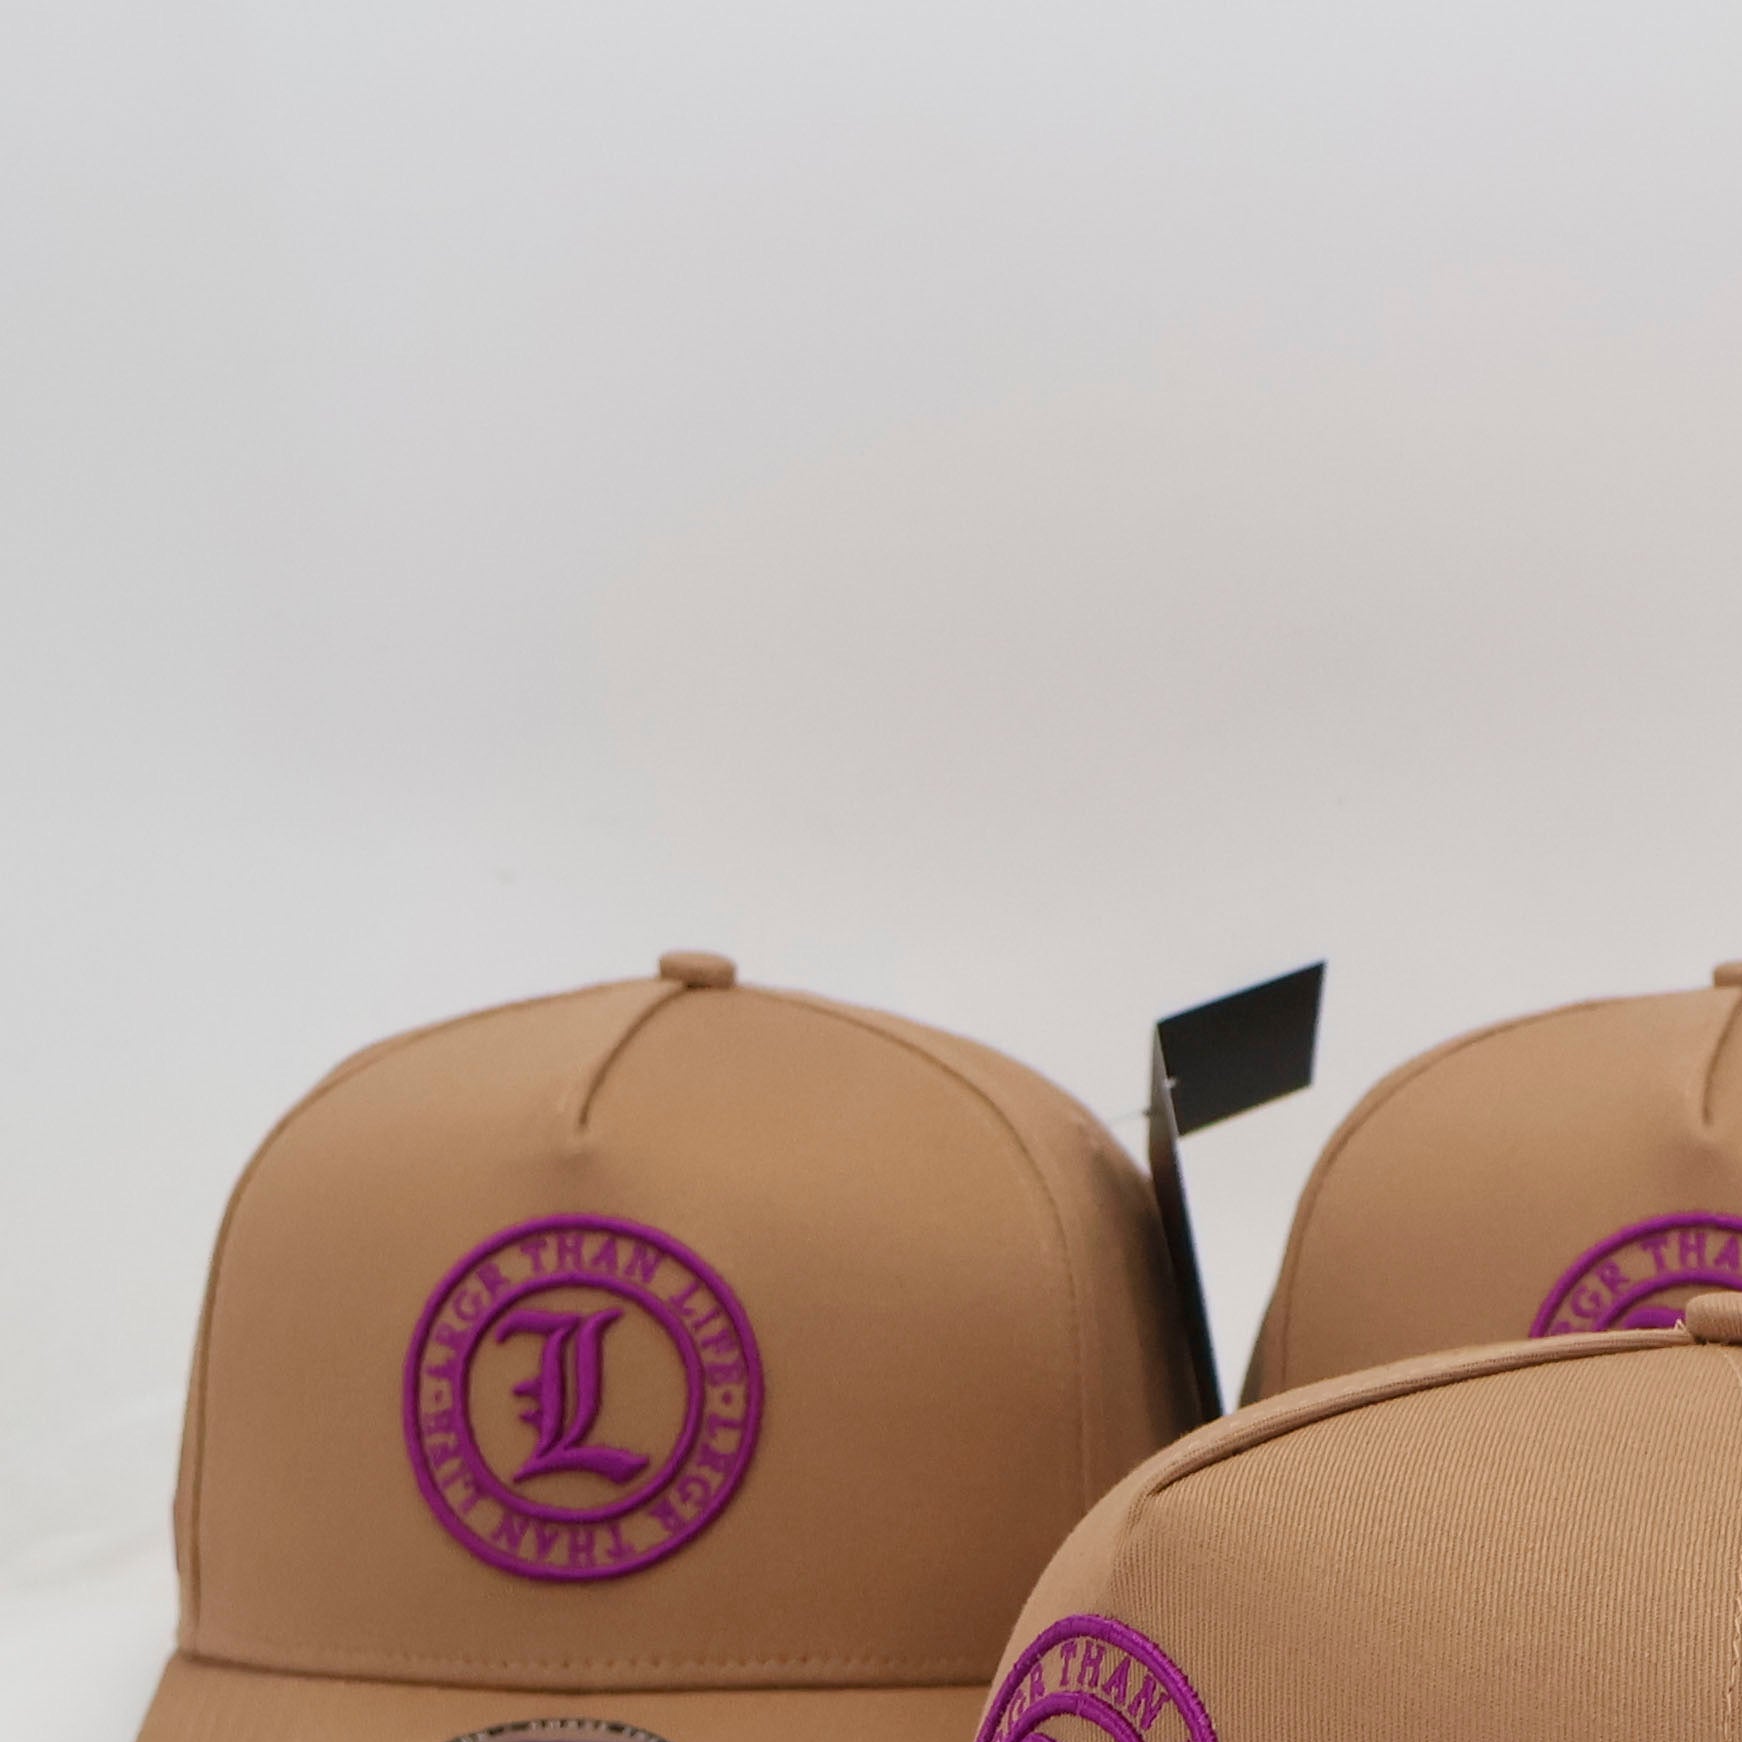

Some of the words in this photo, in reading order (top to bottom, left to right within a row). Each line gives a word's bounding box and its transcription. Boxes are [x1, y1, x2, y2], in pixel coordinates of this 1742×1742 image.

[520, 1232, 662, 1283] THAN
[669, 1280, 746, 1386] LIFE
[497, 1306, 650, 1485] L
[646, 1412, 742, 1534] LRGR
[492, 1514, 636, 1567] THAN
[1060, 1640, 1168, 1730] THAN
